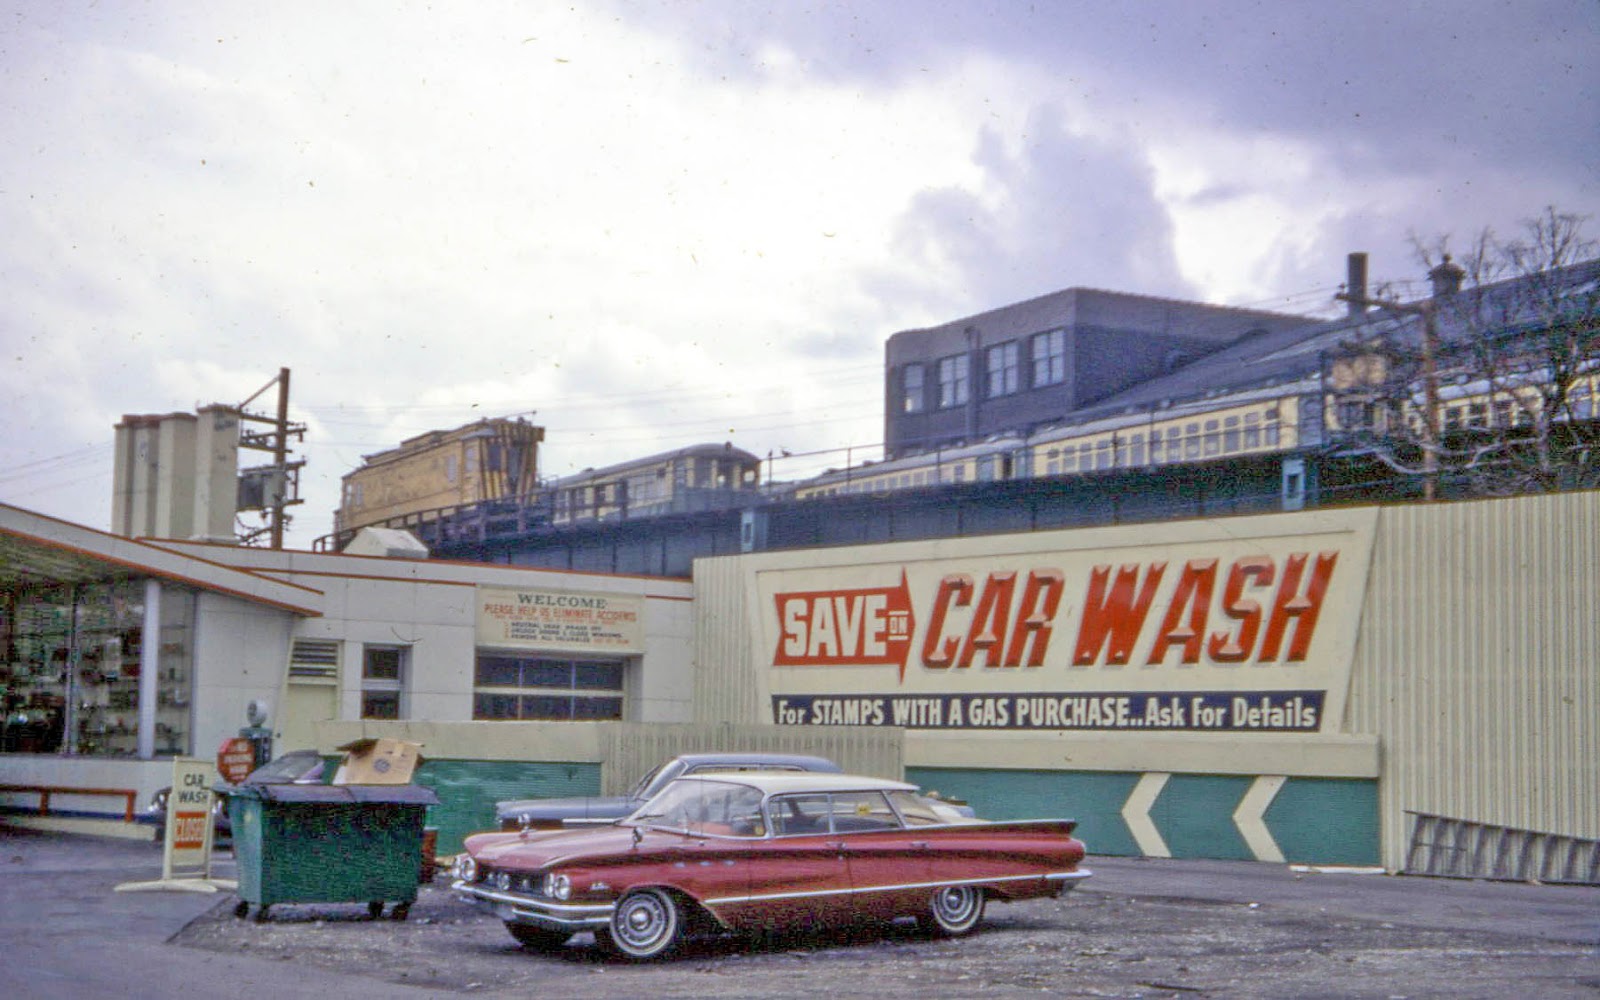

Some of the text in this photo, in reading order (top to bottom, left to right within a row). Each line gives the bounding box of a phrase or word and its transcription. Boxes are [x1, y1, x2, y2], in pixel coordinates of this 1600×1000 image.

[517, 593, 607, 609] WELCOME
[484, 603, 513, 614] PLEASE
[518, 605, 537, 616] HELP
[784, 550, 1340, 669] SAVE ON CAR WASH
[779, 700, 806, 725] For
[811, 700, 885, 726] STAMPS
[892, 699, 943, 726] WITH
[948, 699, 964, 726] A
[968, 698, 1009, 726] GAS
[1145, 698, 1185, 727] Ask
[1191, 698, 1224, 727] For
[1233, 698, 1317, 728] Details
[183, 774, 205, 787] CAR
[178, 791, 208, 803] WASH
